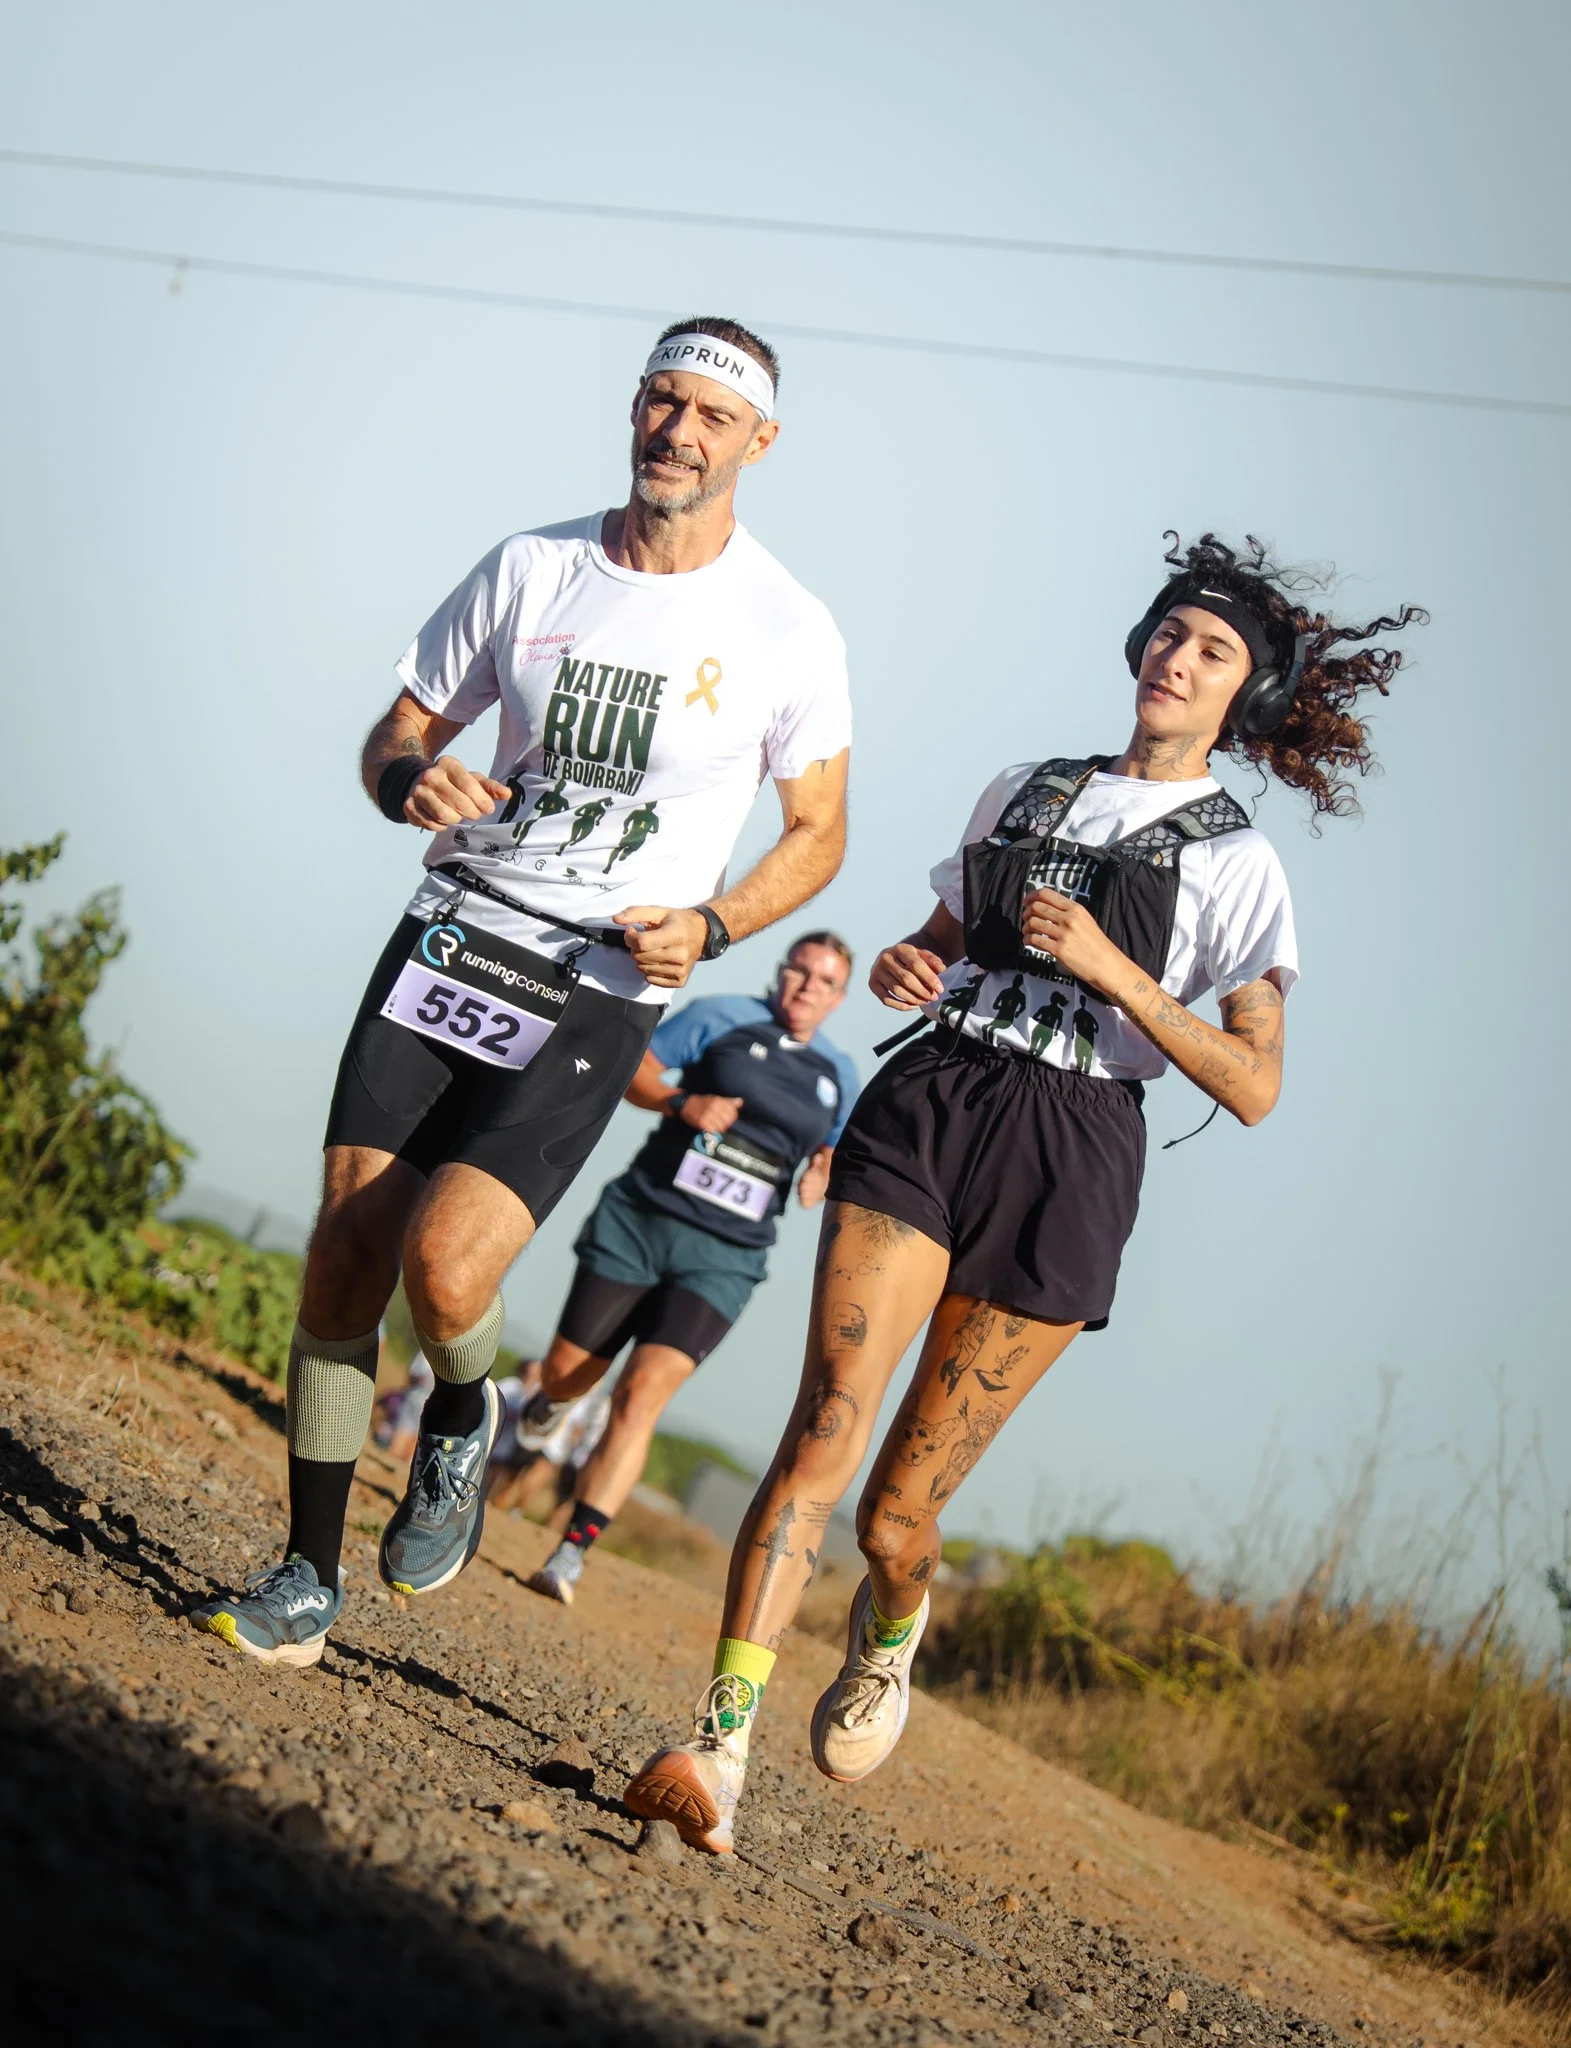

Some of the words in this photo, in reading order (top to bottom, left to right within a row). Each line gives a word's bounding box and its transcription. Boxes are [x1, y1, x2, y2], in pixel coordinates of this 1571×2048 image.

[660, 345, 745, 379] KIPRUN
[512, 632, 576, 647] Association
[554, 656, 668, 711] NATURE
[543, 691, 659, 773] RUN
[543, 752, 560, 780] DE
[561, 758, 645, 797] BOURBAKI
[460, 949, 569, 1006] runningconseil
[416, 983, 521, 1057] 552
[696, 1166, 753, 1205] 573
